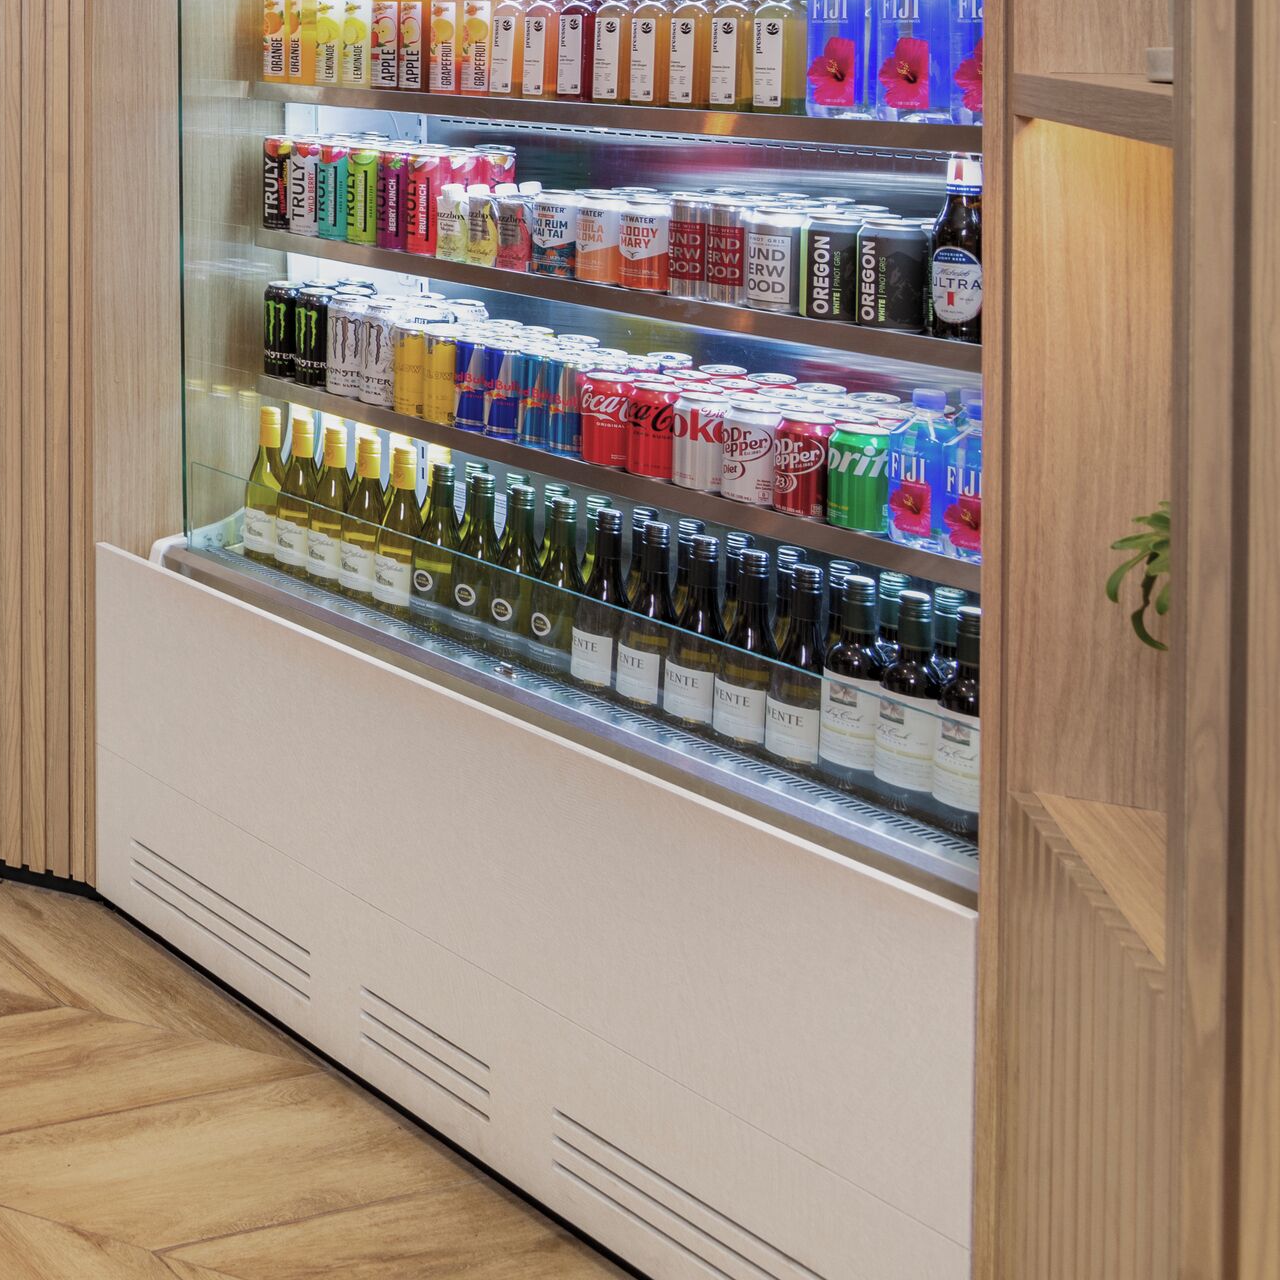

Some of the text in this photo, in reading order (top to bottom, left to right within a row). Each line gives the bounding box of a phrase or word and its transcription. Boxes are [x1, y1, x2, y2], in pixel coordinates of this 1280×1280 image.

[271, 37, 283, 72] ORANGE
[290, 37, 300, 73] ORANGE
[324, 44, 335, 79] LEMONADE
[353, 45, 363, 80] LEMONADE
[381, 49, 396, 82] APPLE
[441, 41, 452, 86] GRAPEFRUIT
[473, 41, 486, 87] GRAPEFRUIT
[405, 50, 420, 83] APPLE
[264, 156, 279, 217] TRULY
[292, 161, 306, 220] TRULY
[388, 208, 396, 232] BERRY
[545, 219, 568, 230] RUM
[547, 228, 563, 239] TAI
[621, 236, 651, 249] MARY
[668, 231, 700, 245] UND
[668, 246, 701, 260] ERW
[708, 250, 740, 264] ERW
[749, 247, 786, 261] UND
[668, 260, 700, 274] OOD
[749, 262, 785, 278] ERW
[812, 235, 831, 314] OREGON
[833, 265, 841, 287] PINOT
[748, 278, 786, 294] OOD
[861, 240, 876, 321] OREGON
[878, 256, 887, 322] WHITE PINOT GRIS
[832, 292, 841, 315] WHITE
[730, 426, 752, 441] Dr
[781, 438, 803, 453] Dr
[723, 463, 738, 474] Diet
[775, 450, 820, 470] epper
[891, 452, 926, 484] FIJI
[715, 687, 751, 707] WENTE
